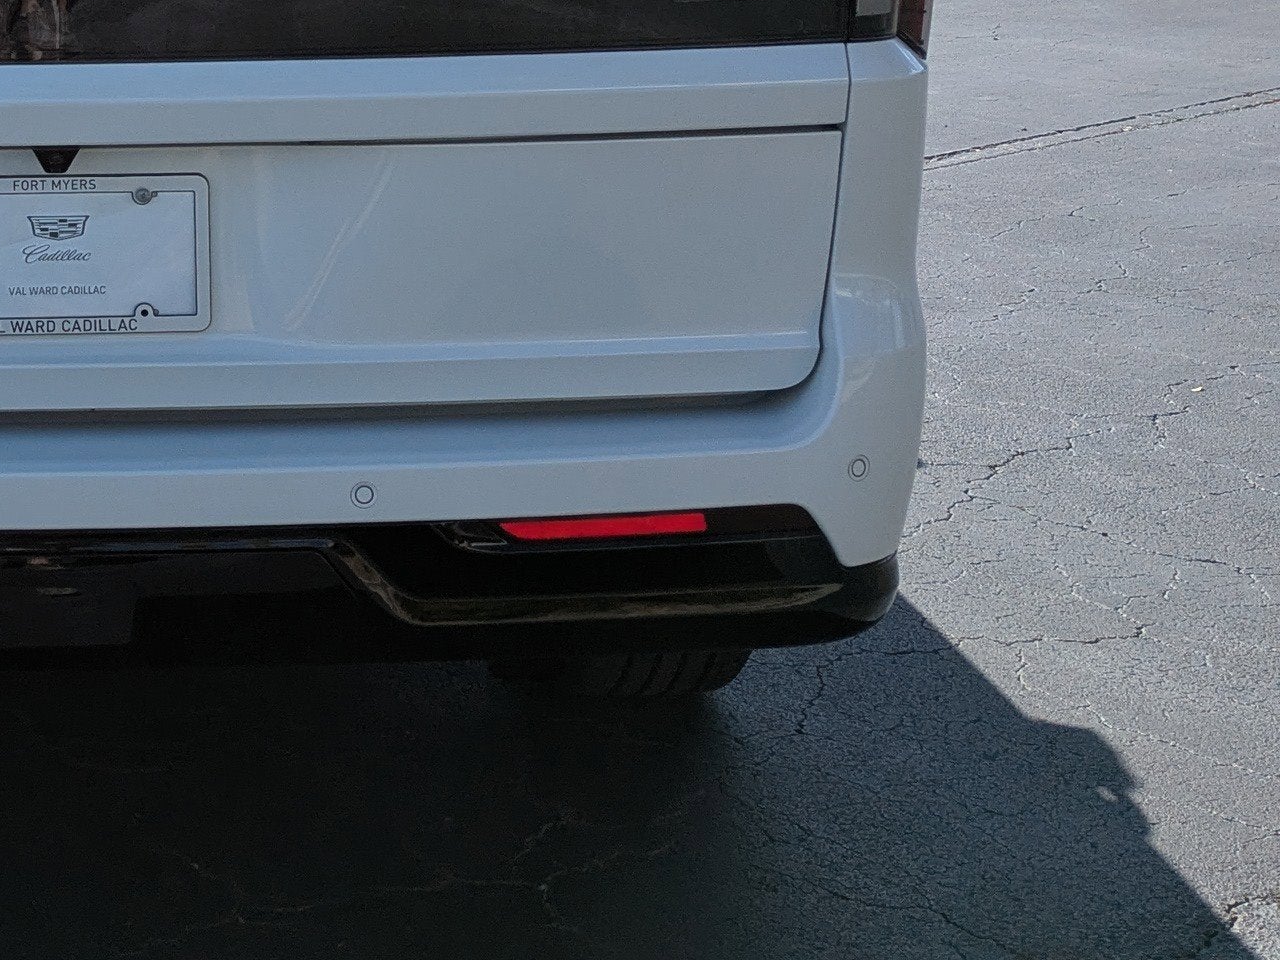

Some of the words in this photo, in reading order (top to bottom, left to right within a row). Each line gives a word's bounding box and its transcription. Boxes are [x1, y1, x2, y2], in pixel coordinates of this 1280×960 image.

[13, 179, 47, 191] FORT
[51, 179, 97, 190] MYERS
[22, 244, 92, 264] Cadillac
[8, 286, 27, 296] VAL
[29, 286, 59, 296] WARD
[60, 285, 107, 295] CADILLAC
[10, 320, 56, 333] WARD
[61, 318, 138, 332] CADILLAC
